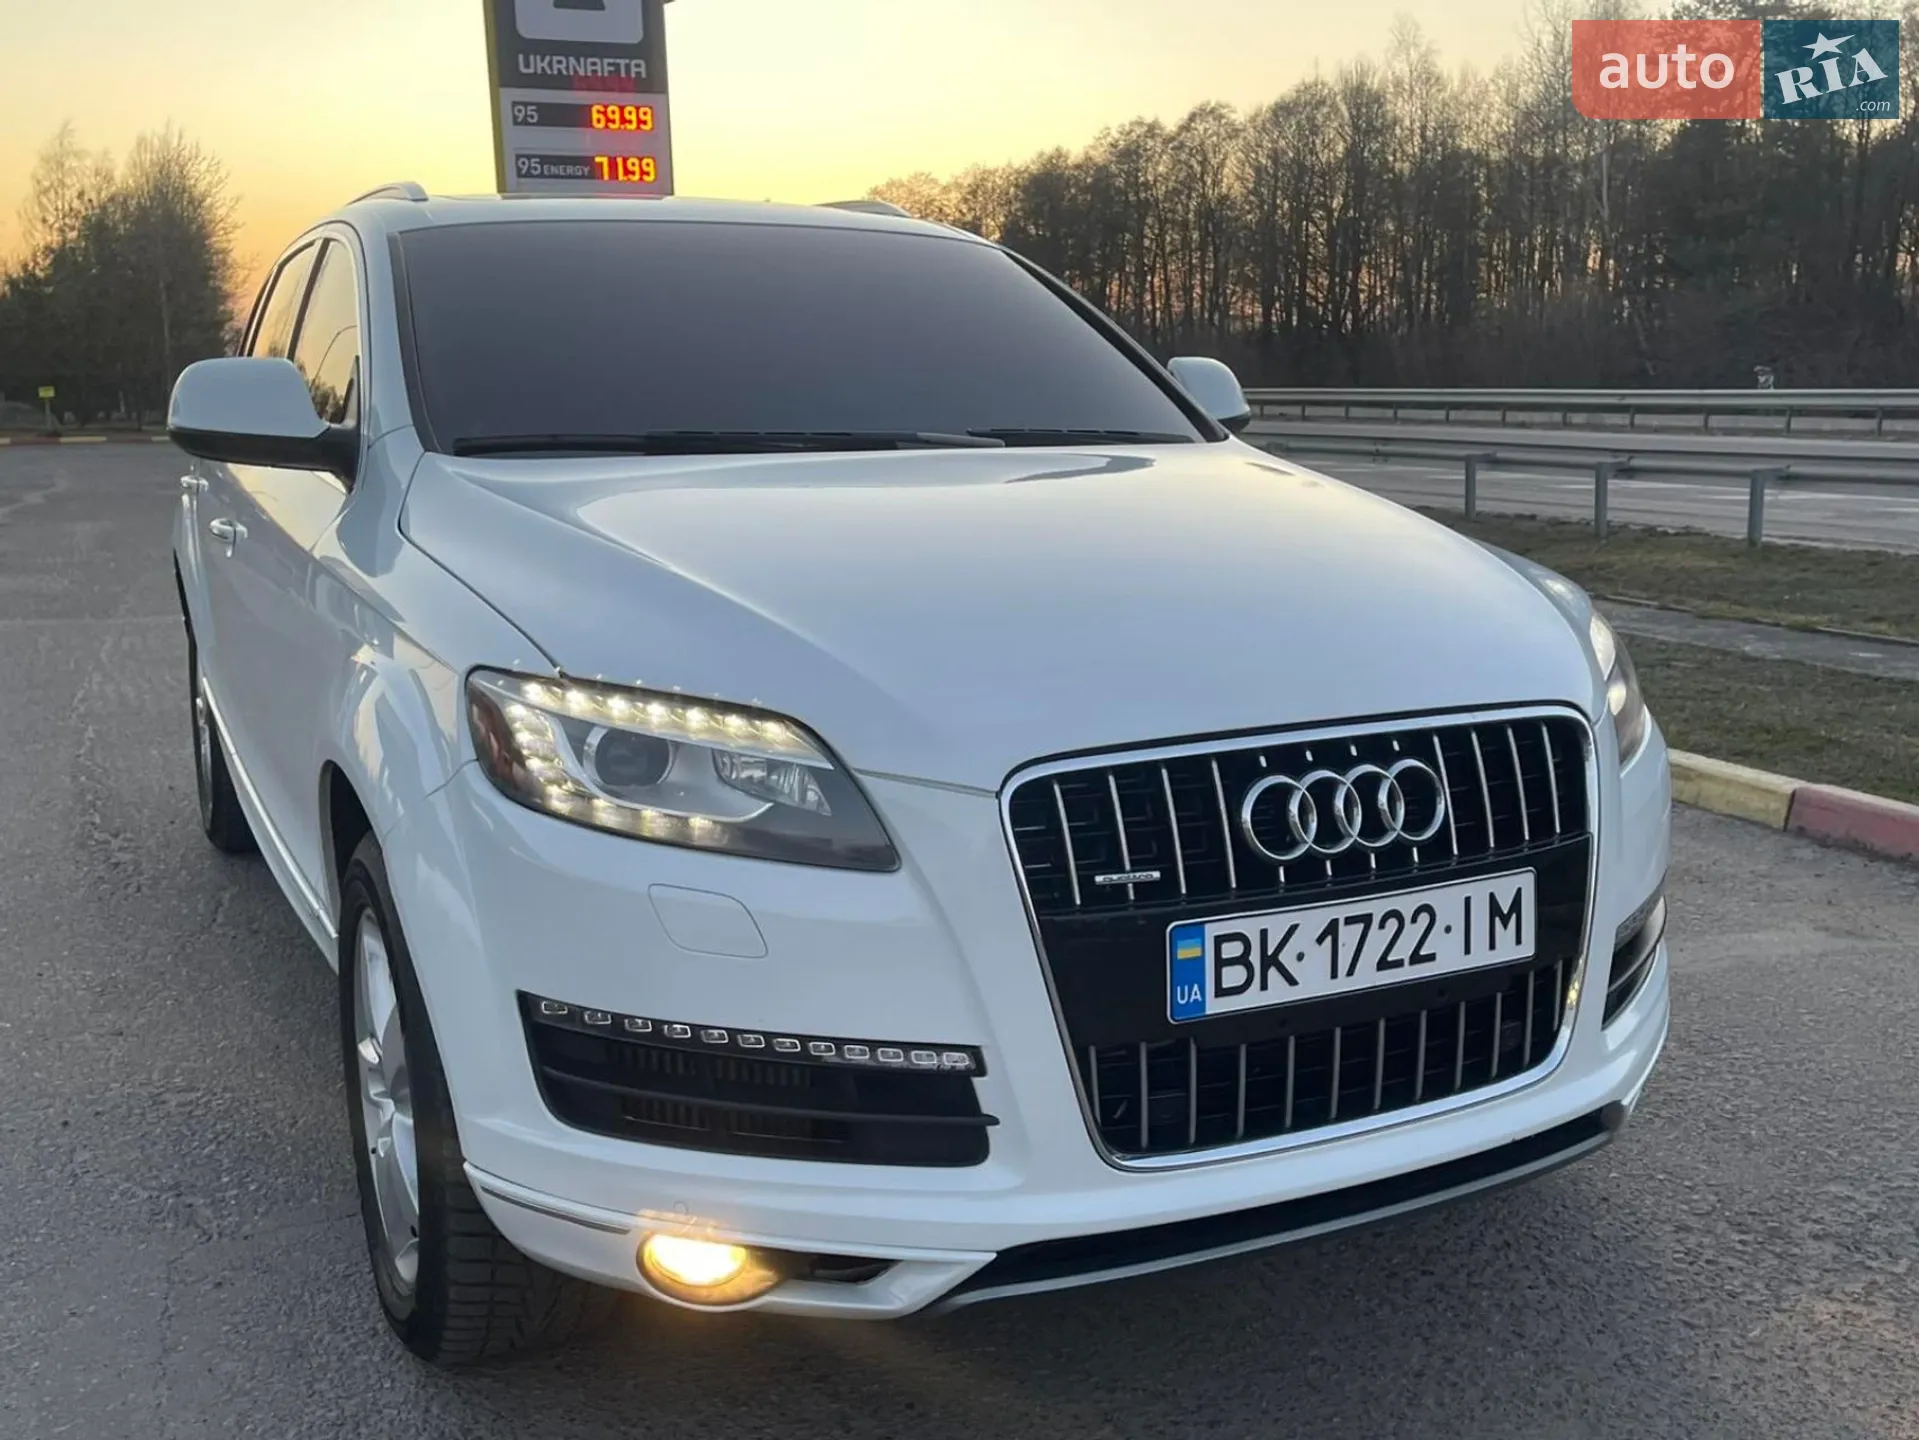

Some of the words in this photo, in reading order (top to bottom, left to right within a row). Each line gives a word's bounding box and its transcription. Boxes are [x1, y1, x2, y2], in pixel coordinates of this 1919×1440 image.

[518, 53, 647, 79] UKRNAFTA
[513, 105, 539, 124] 95
[591, 104, 653, 131] 69.99
[517, 157, 542, 176] 95
[543, 164, 590, 177] ENERGY
[1315, 903, 1437, 980] 1722
[1177, 983, 1203, 1005] UA
